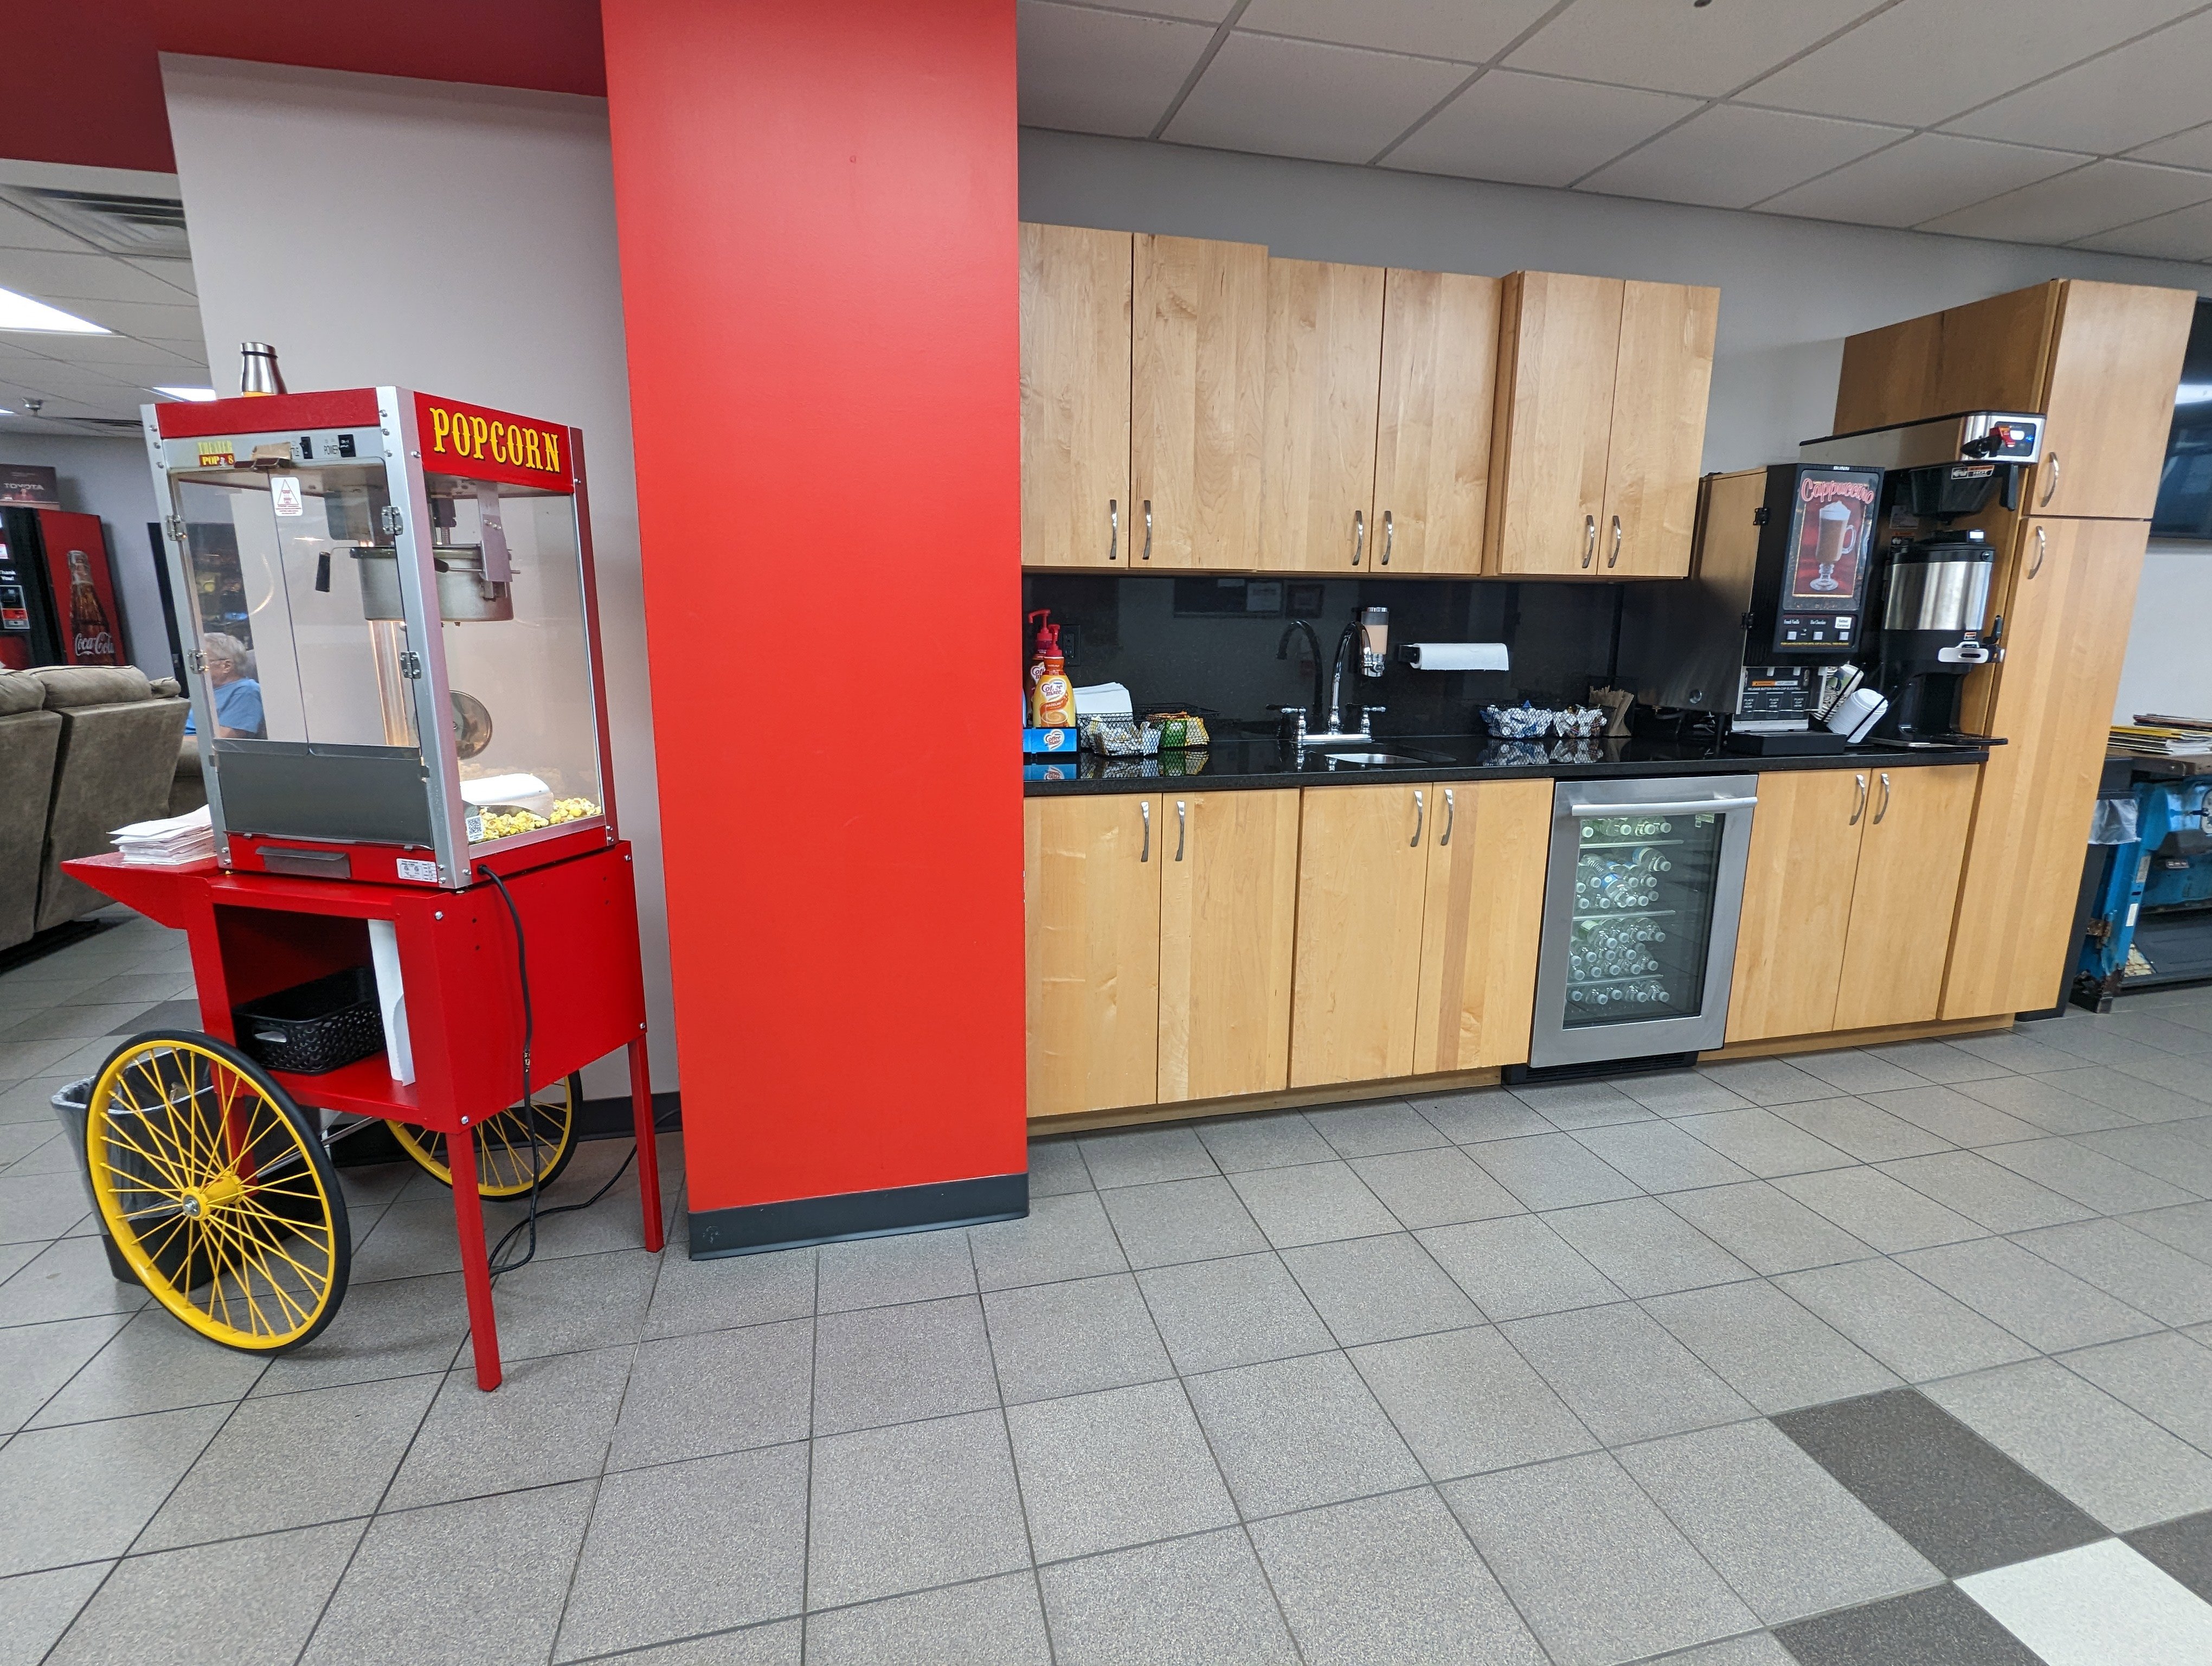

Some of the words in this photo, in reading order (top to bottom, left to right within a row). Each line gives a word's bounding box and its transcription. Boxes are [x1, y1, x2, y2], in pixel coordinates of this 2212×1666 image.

[429, 407, 560, 472] POPCORN
[202, 456, 220, 465] POP
[1801, 478, 1874, 504] Cappuccino
